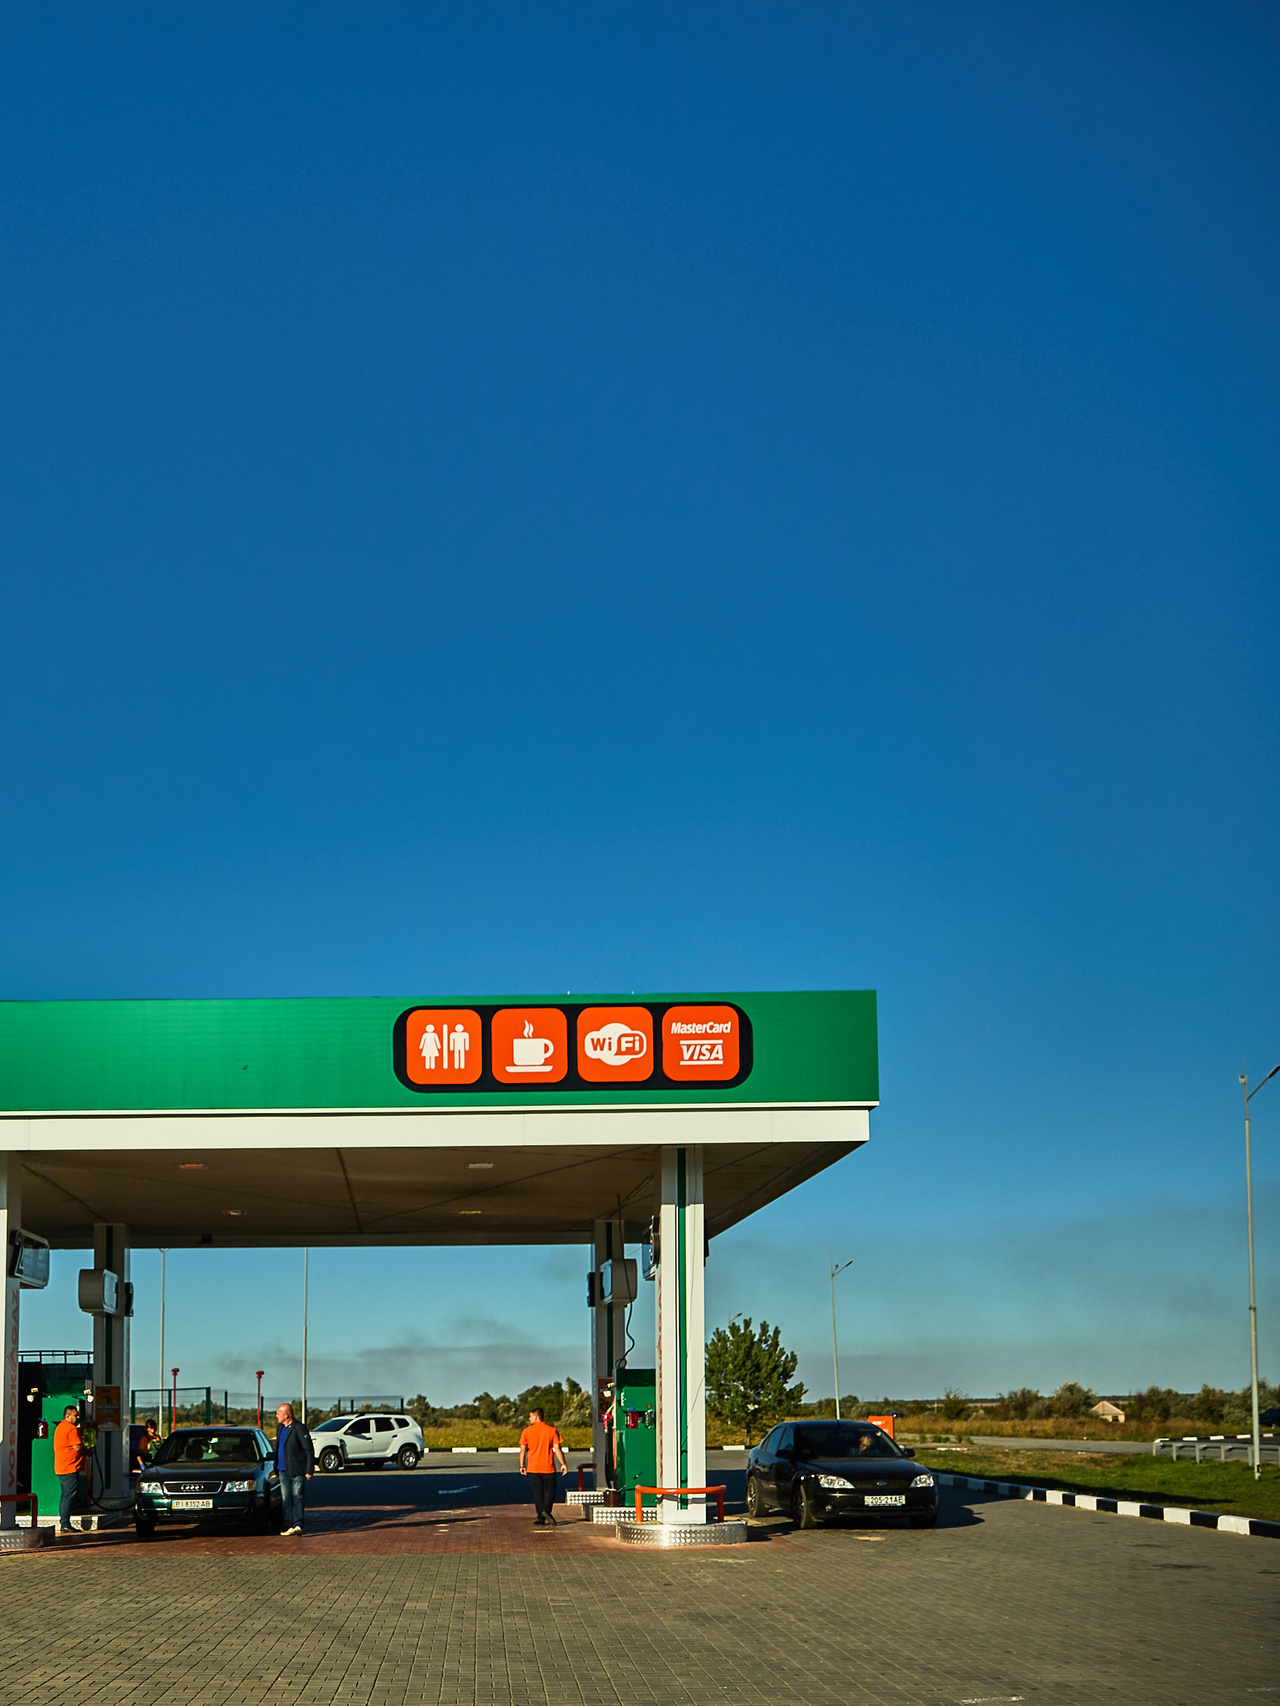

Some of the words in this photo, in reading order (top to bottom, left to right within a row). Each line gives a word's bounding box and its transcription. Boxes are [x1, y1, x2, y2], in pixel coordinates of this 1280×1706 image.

[671, 1021, 732, 1035] MasterCard
[681, 1044, 724, 1061] VISA
[11, 1288, 20, 1341] GAZ
[8, 1376, 17, 1489] VOSTOK
